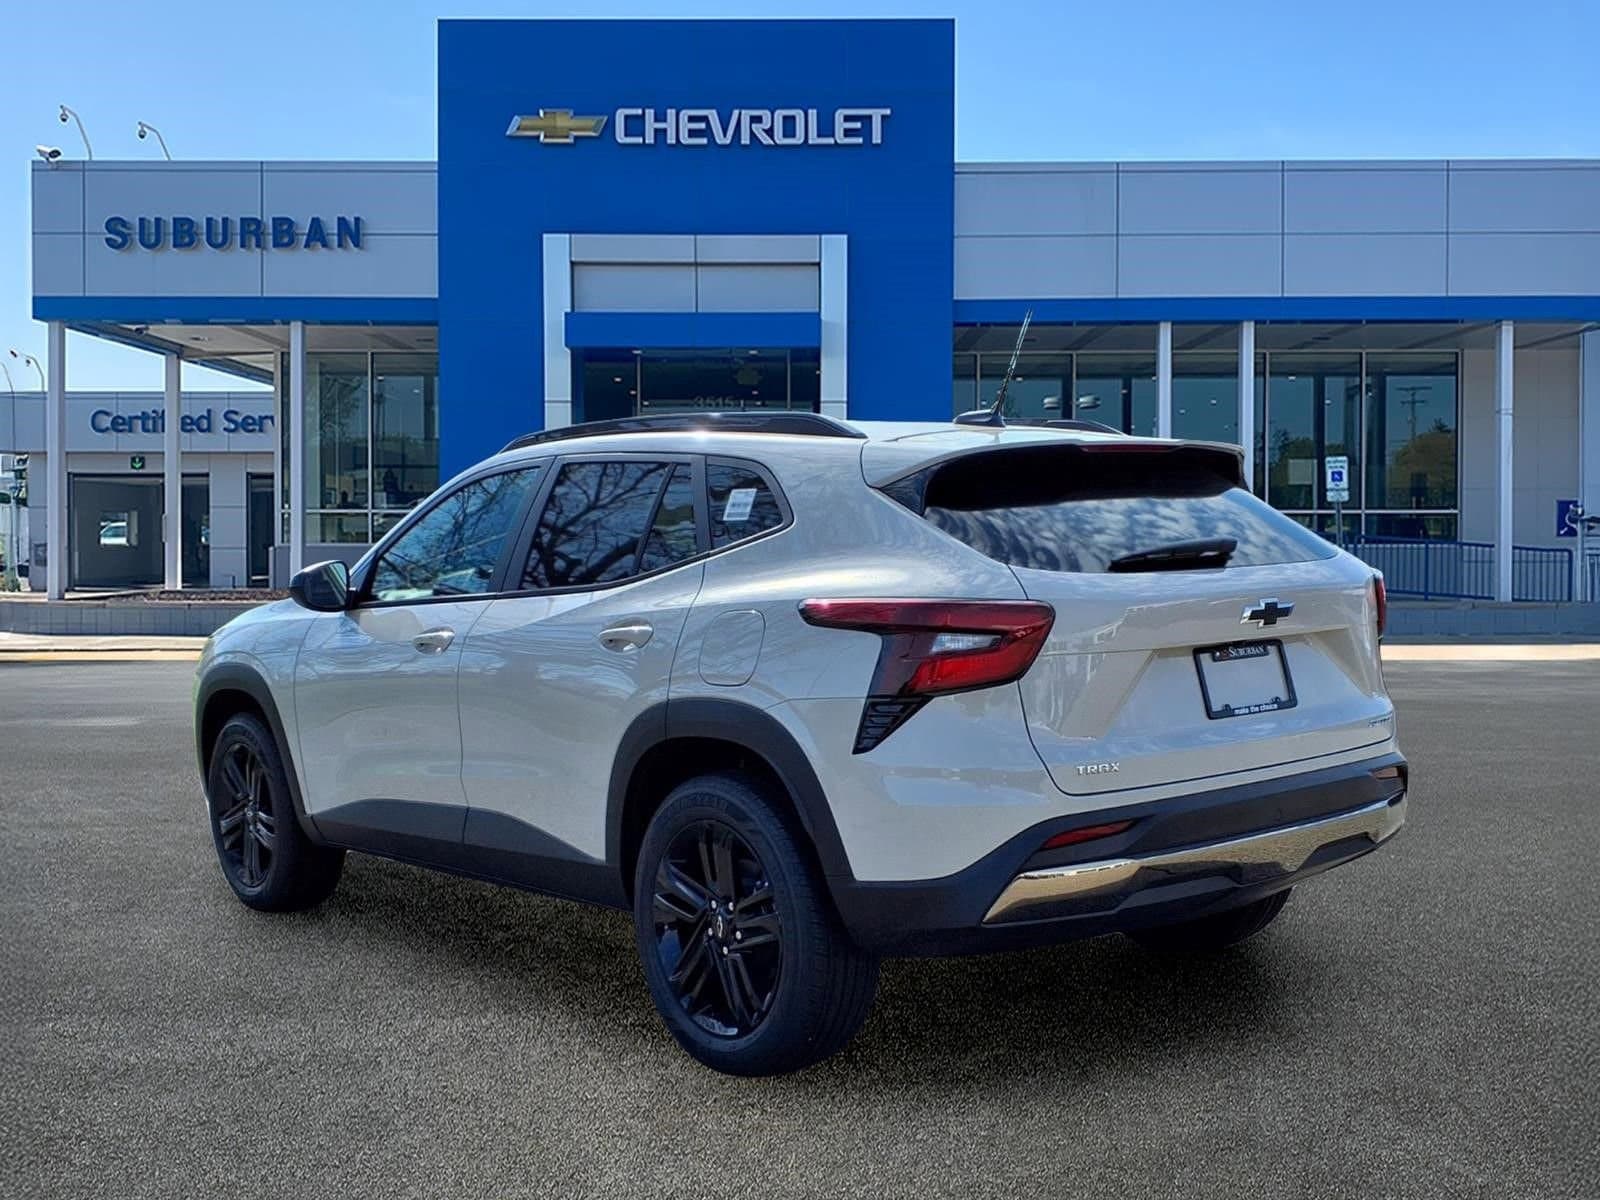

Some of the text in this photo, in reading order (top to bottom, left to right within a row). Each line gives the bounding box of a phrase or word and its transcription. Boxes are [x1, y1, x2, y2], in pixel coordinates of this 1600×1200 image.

[615, 108, 892, 145] CHEVROLET
[104, 216, 363, 250] SUBURBAN
[1077, 762, 1120, 775] TRAX
